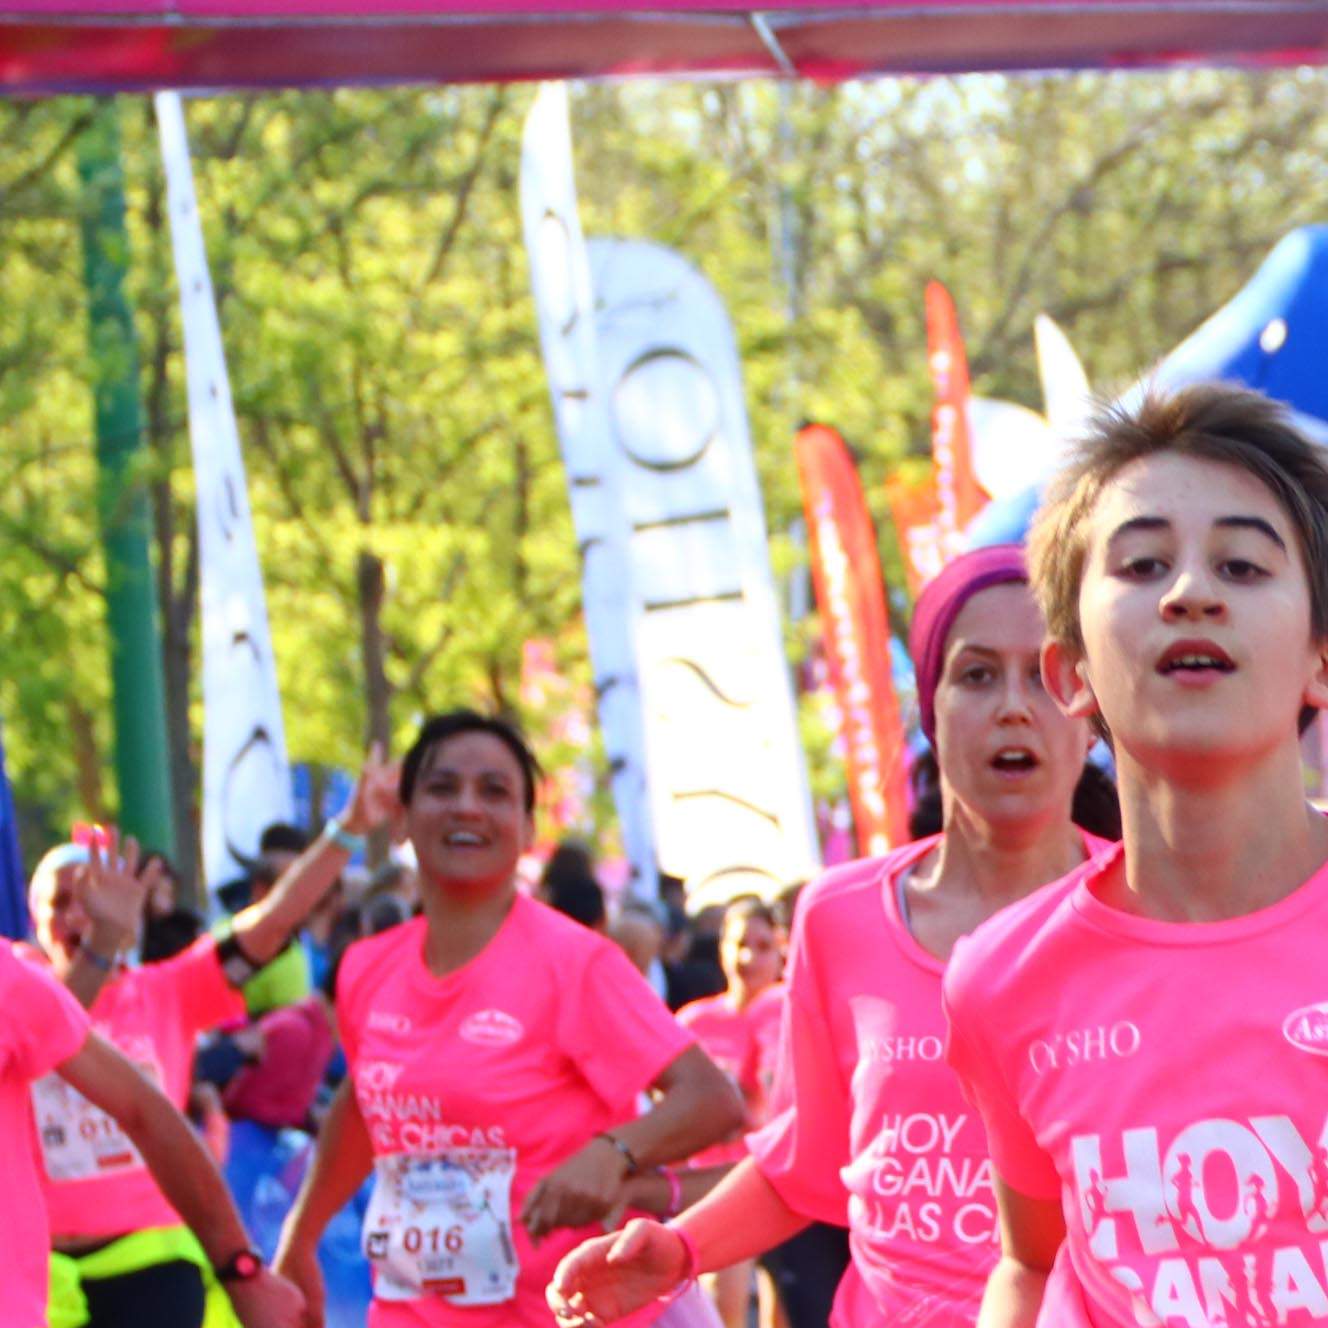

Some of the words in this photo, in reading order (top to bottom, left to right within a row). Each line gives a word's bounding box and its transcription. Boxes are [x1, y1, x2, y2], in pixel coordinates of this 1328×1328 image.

[882, 1112, 967, 1154] HOY
[402, 1225, 465, 1255] 016
[871, 1201, 943, 1242] LAS
